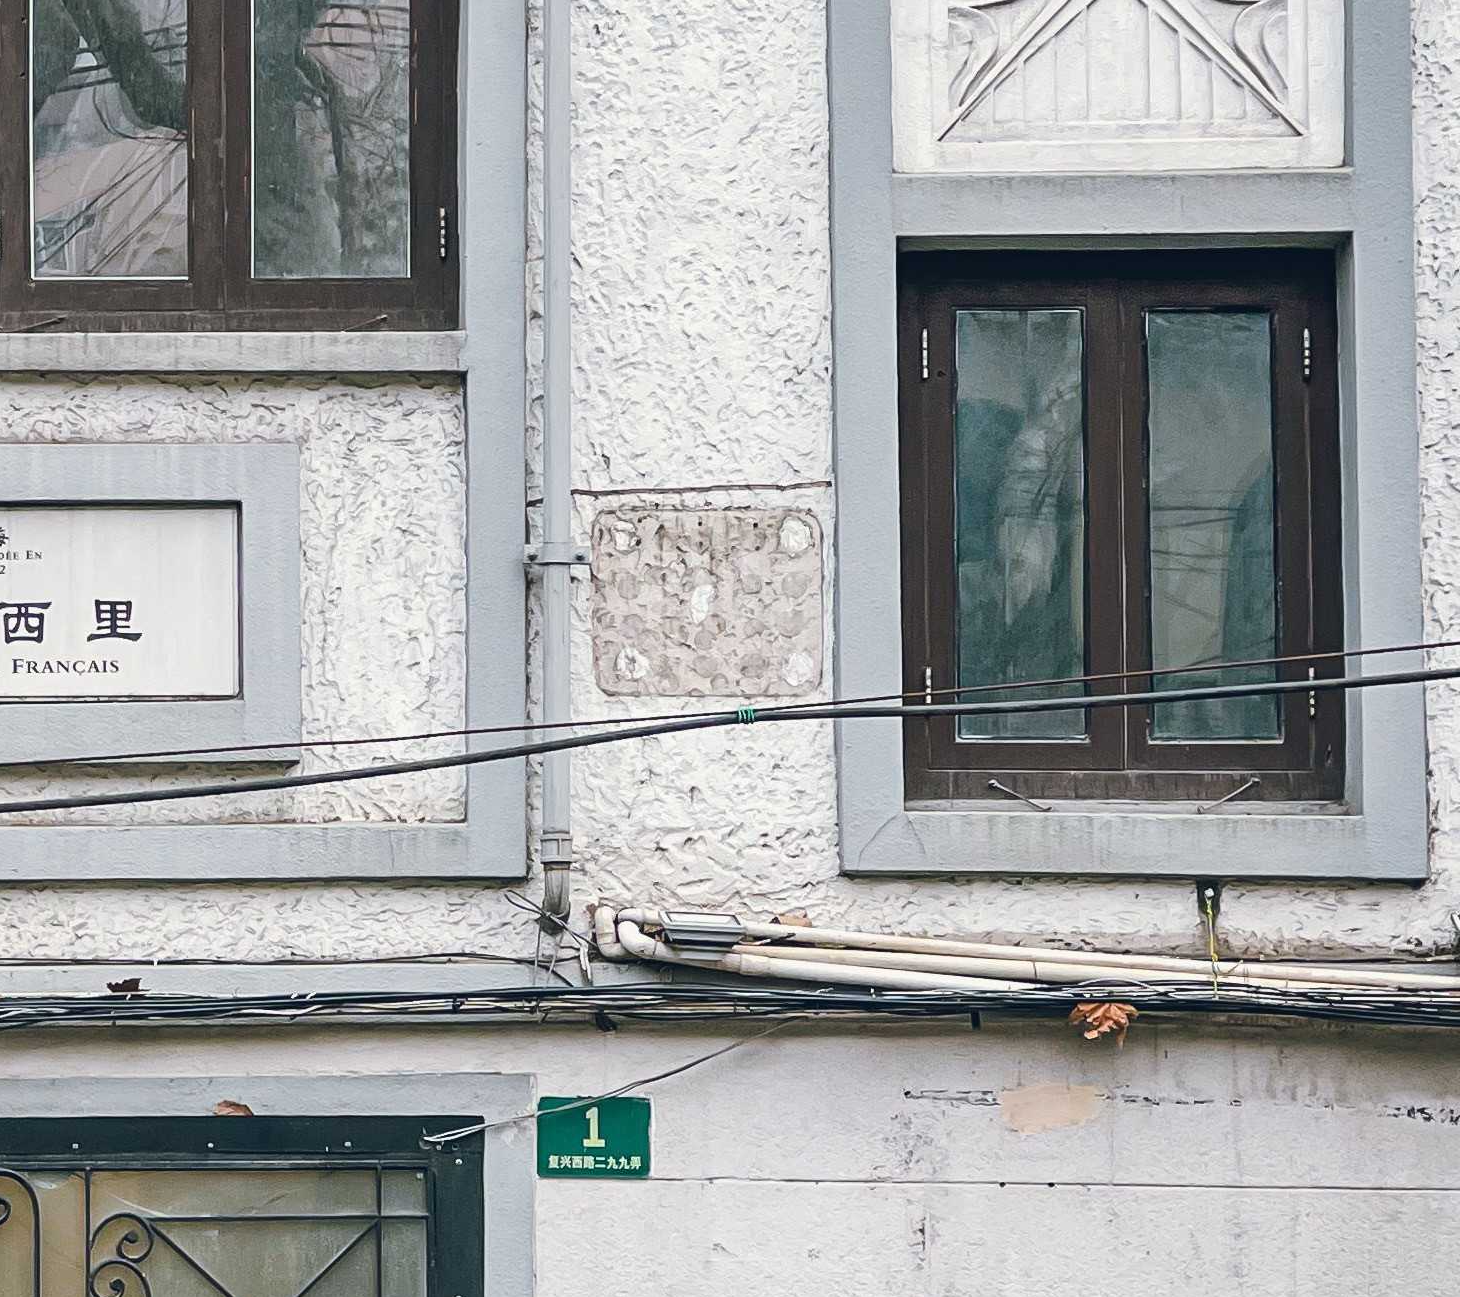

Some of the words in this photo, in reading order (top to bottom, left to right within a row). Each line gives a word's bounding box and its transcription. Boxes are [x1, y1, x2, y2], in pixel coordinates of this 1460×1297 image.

[11, 658, 120, 679] FRANÇAIS
[582, 1106, 606, 1148] 1
[548, 1155, 641, 1170] 复兴西路二九九弄
